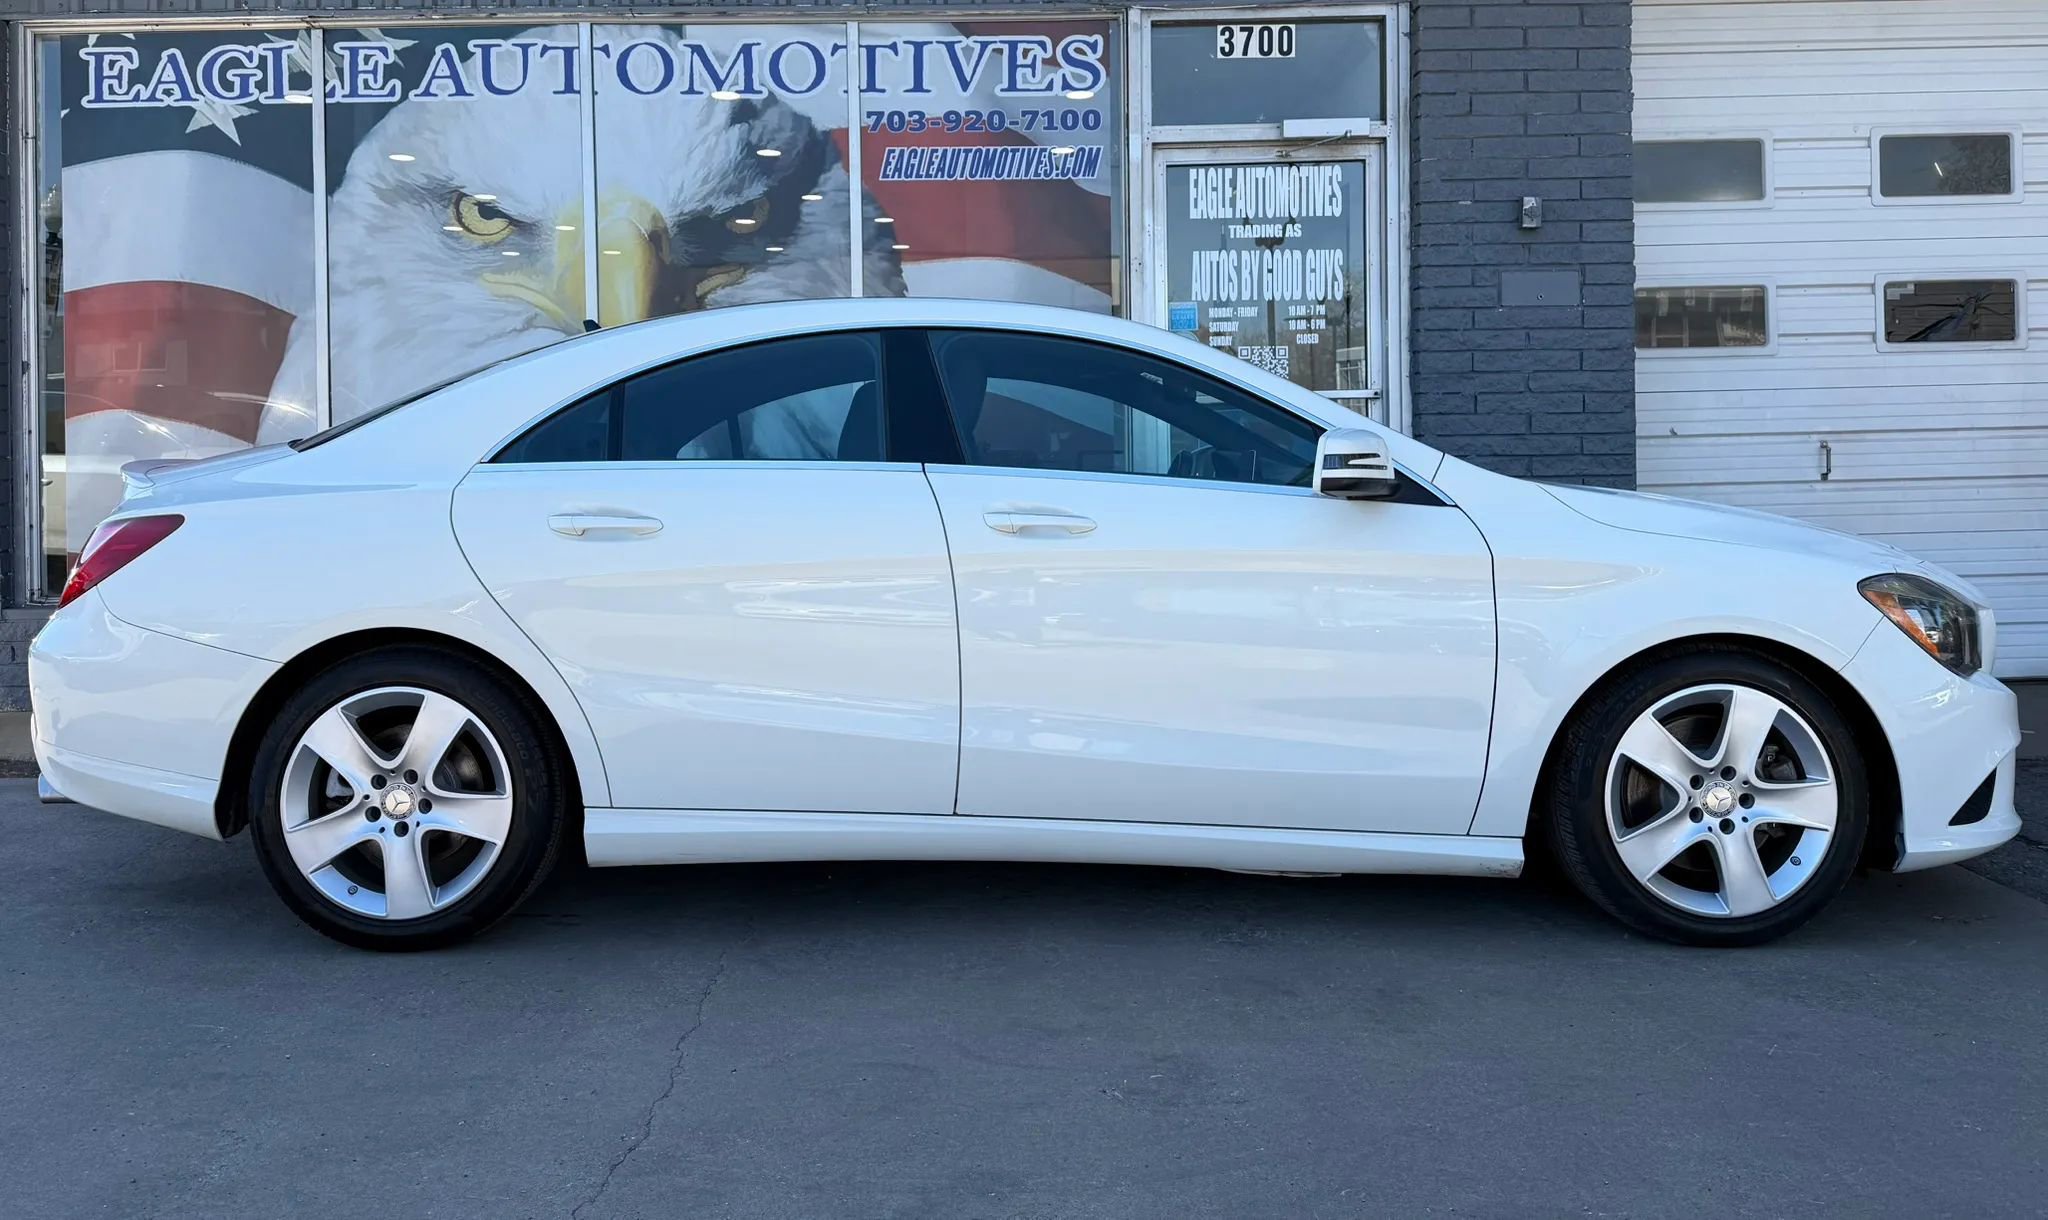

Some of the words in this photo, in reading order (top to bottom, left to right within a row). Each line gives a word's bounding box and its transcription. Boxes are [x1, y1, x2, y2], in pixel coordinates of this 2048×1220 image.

[1218, 25, 1294, 57] 3700
[81, 40, 402, 108] EAGLE
[411, 35, 1105, 98] AUTOMOTIVES
[865, 108, 1103, 134] 703-920-7100
[879, 145, 1103, 181] EAGLEAUTOMOTIVES.COM
[1189, 168, 1233, 220] EAGLE
[1235, 164, 1343, 219] AUTOMOTIVES
[1228, 224, 1283, 239] TRADING
[1285, 223, 1302, 238] AS
[1191, 249, 1238, 302] AUTOS
[1241, 250, 1260, 301] BY
[1263, 249, 1301, 301] GOOD
[1306, 248, 1344, 301] GUYS
[1208, 307, 1234, 318] MONDAY
[1237, 306, 1258, 318] FRIDAY
[1288, 305, 1296, 316] 10
[1296, 305, 1307, 316] AM
[1316, 304, 1326, 316] PM
[1208, 321, 1239, 333] SATURDAY
[1288, 319, 1296, 330] 10
[1296, 319, 1307, 330] AM
[1315, 319, 1326, 330] PM
[1208, 335, 1233, 347] SUNDAY
[1296, 333, 1319, 345] CLOSED
